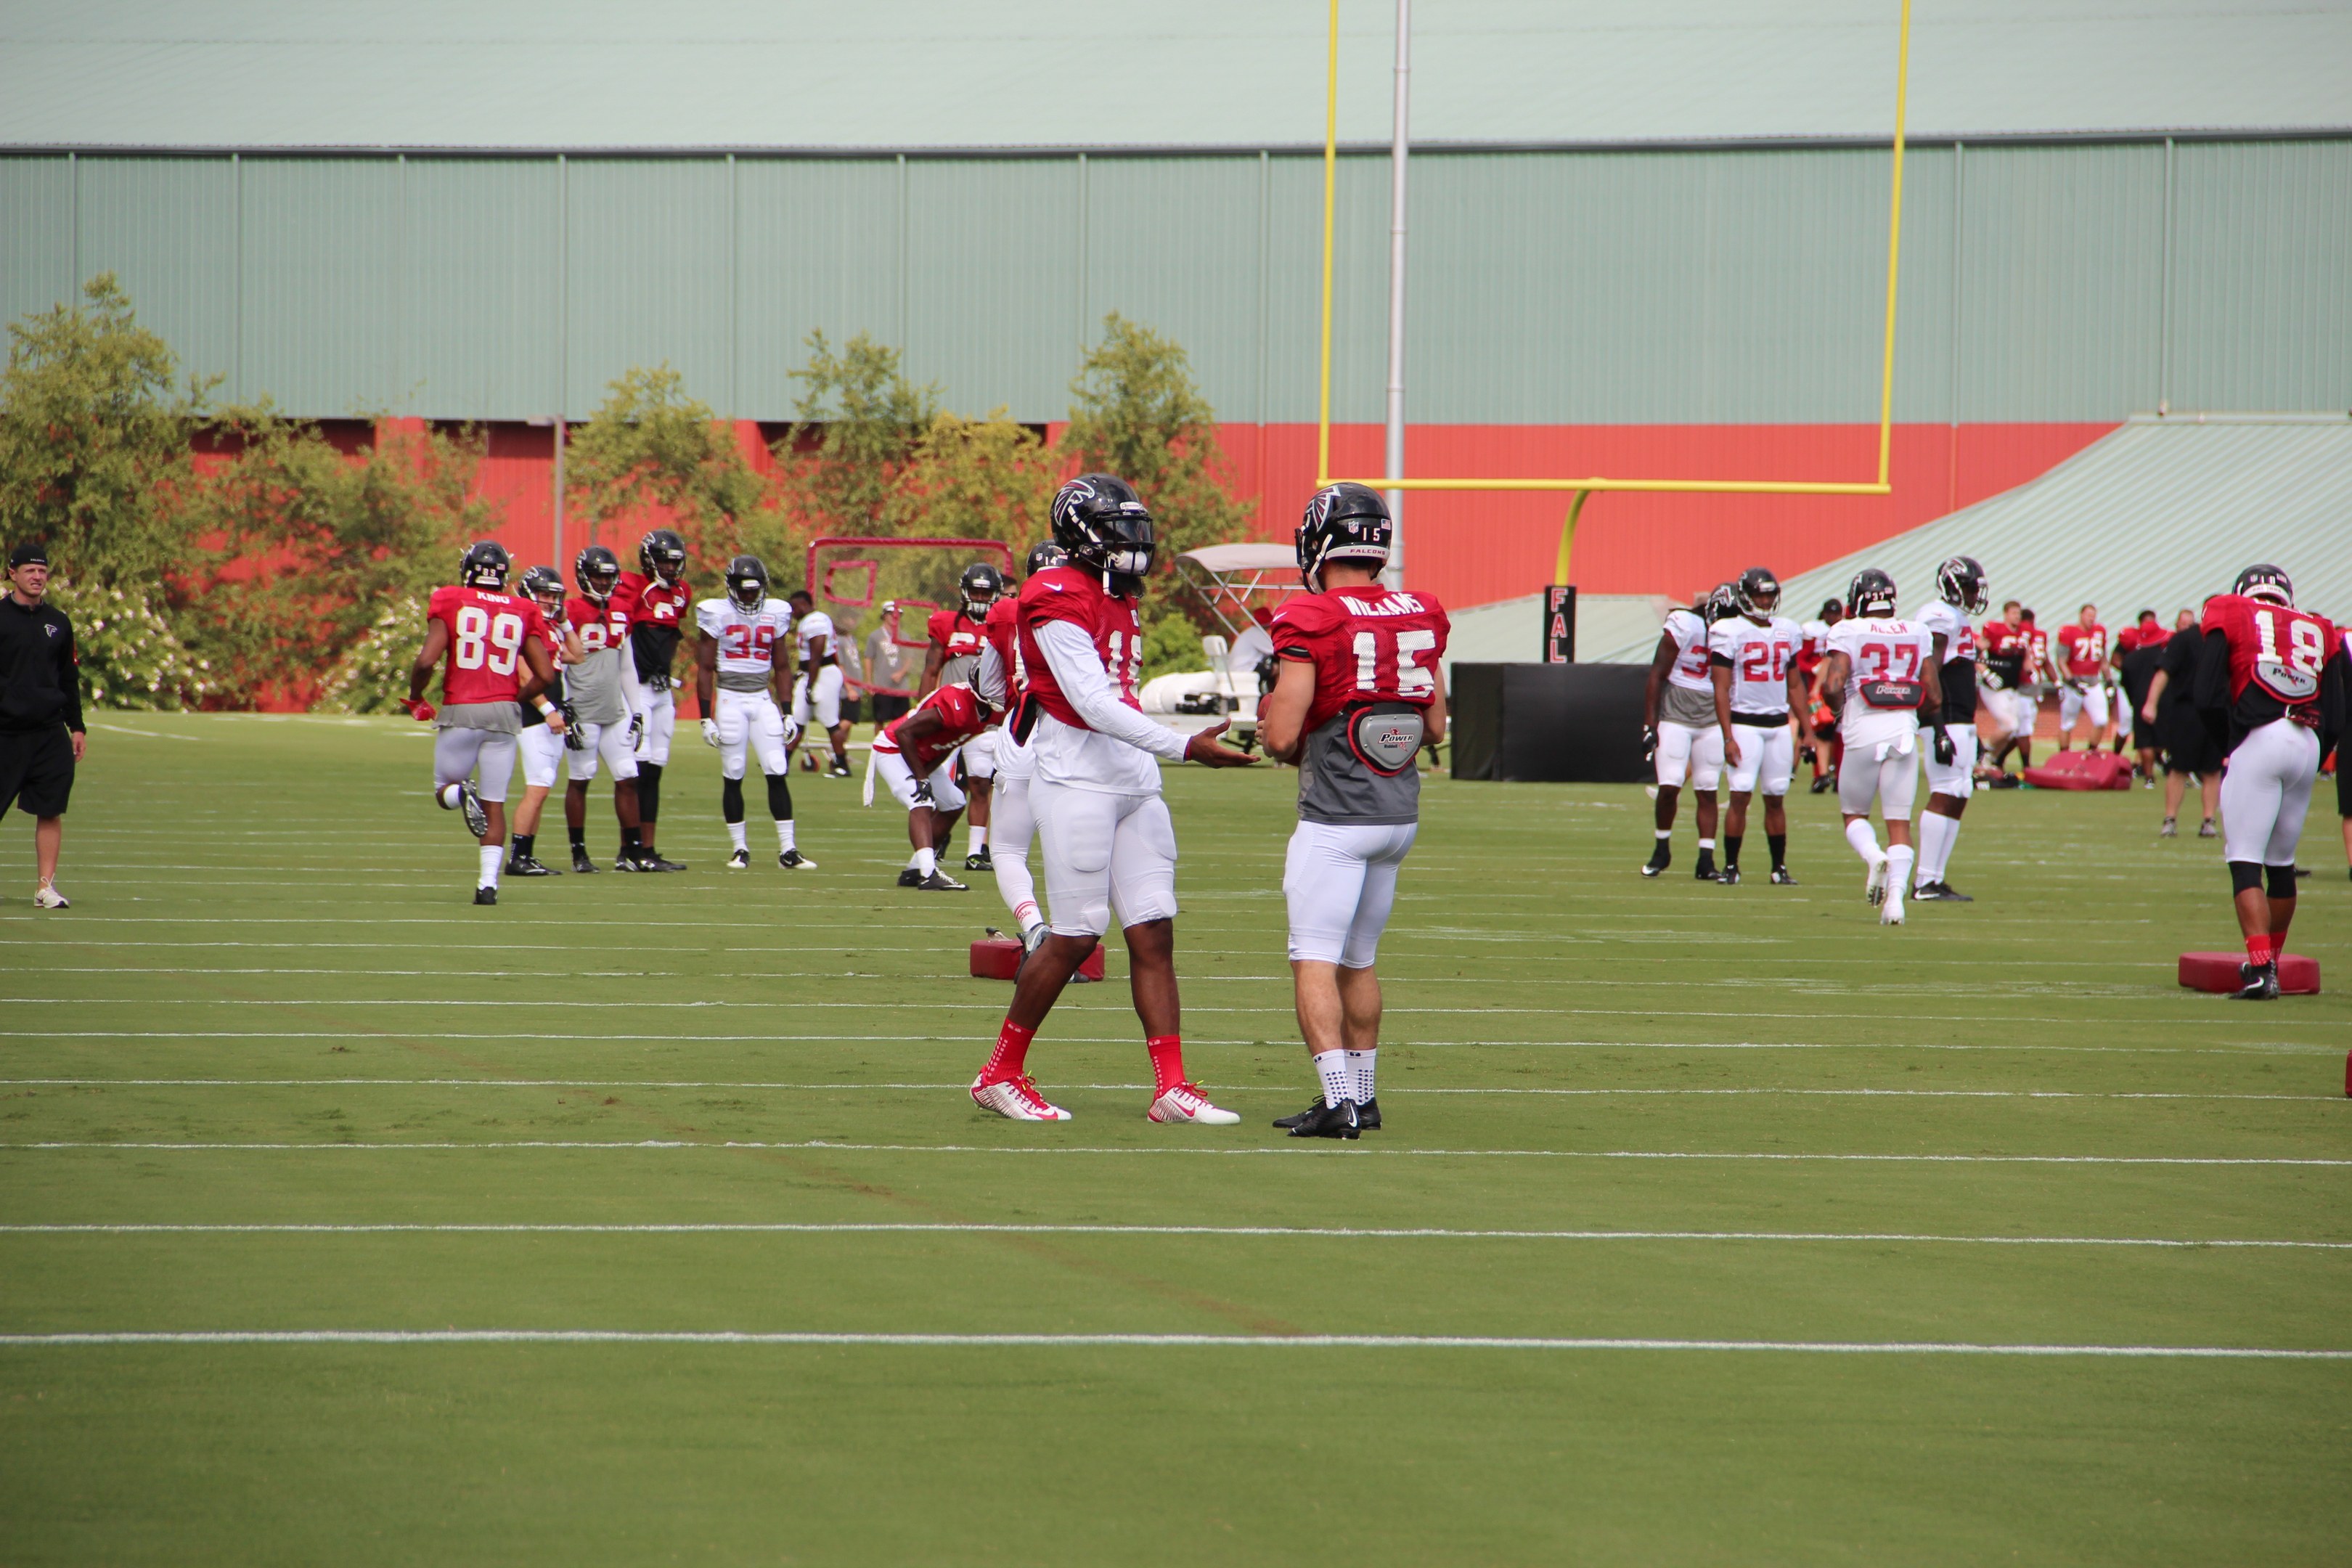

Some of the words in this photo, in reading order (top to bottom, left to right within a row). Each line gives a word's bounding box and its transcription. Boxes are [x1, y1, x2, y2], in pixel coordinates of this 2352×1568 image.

[1363, 527, 1380, 541] 15
[1045, 556, 1056, 565] 14
[482, 568, 497, 576] 89
[476, 591, 510, 604] KING
[1872, 592, 1885, 601] 37
[456, 606, 523, 676] 89
[2255, 610, 2324, 678] 18
[1349, 629, 1436, 698] 15
[1744, 642, 1791, 682] 20
[1861, 643, 1919, 683] 37
[1379, 732, 1414, 743] POWER
